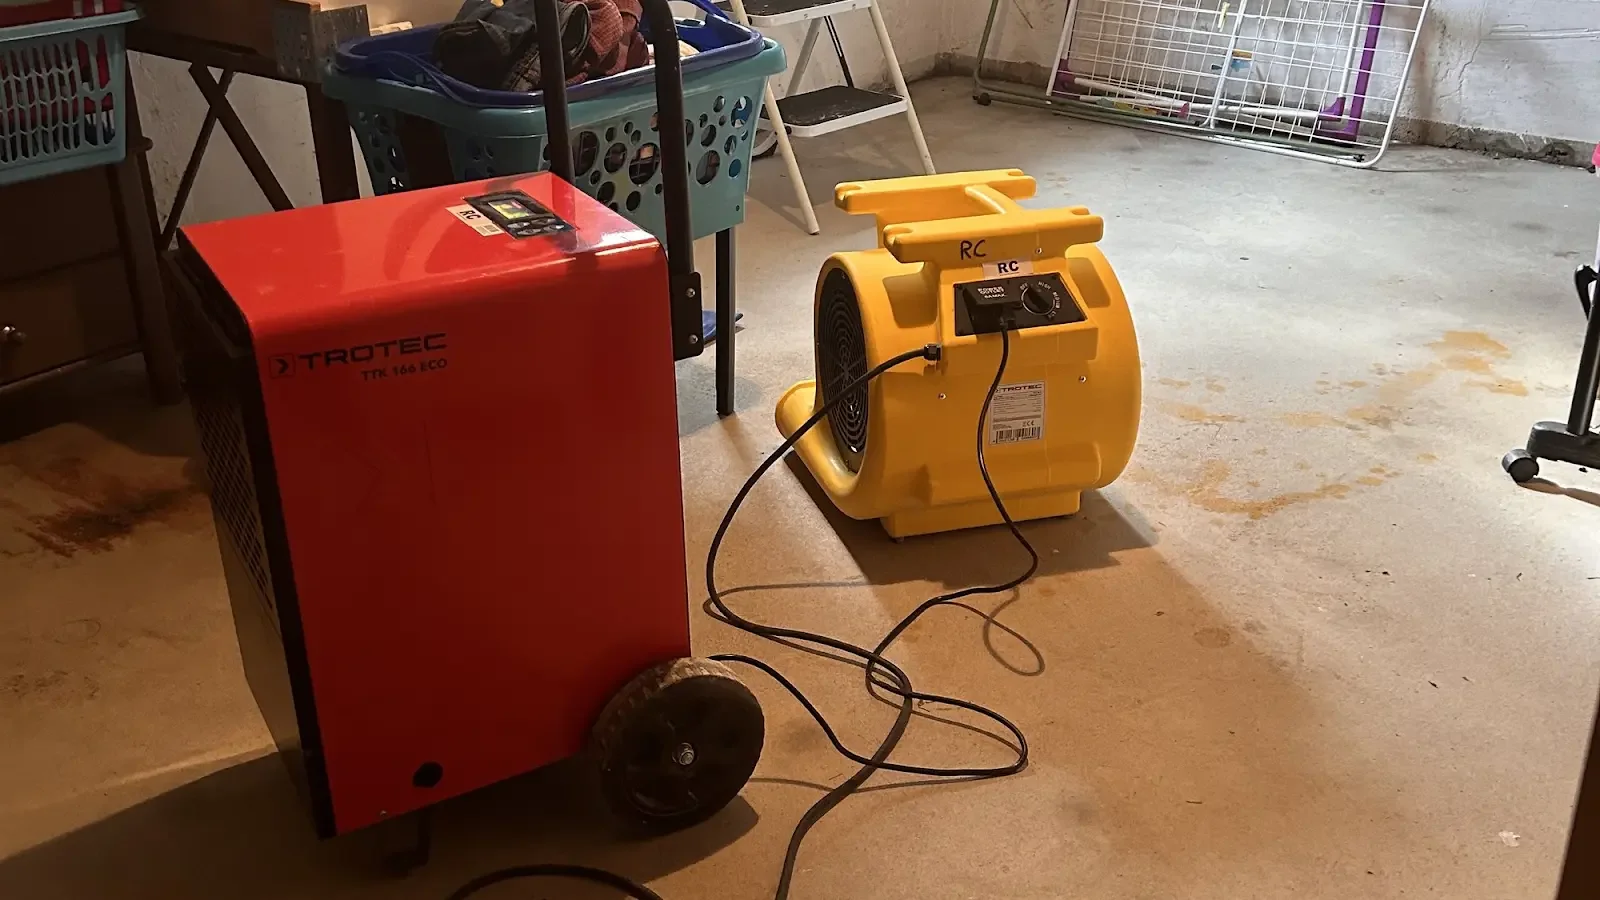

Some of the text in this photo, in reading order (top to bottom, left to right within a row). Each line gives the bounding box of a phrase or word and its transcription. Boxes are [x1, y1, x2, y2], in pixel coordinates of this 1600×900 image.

[459, 210, 481, 220] RC
[960, 239, 987, 260] RC
[997, 260, 1020, 274] RC
[298, 333, 447, 370] TROTEC
[361, 357, 448, 381] TTK 166 ECO
[1001, 383, 1043, 393] TROTEC
